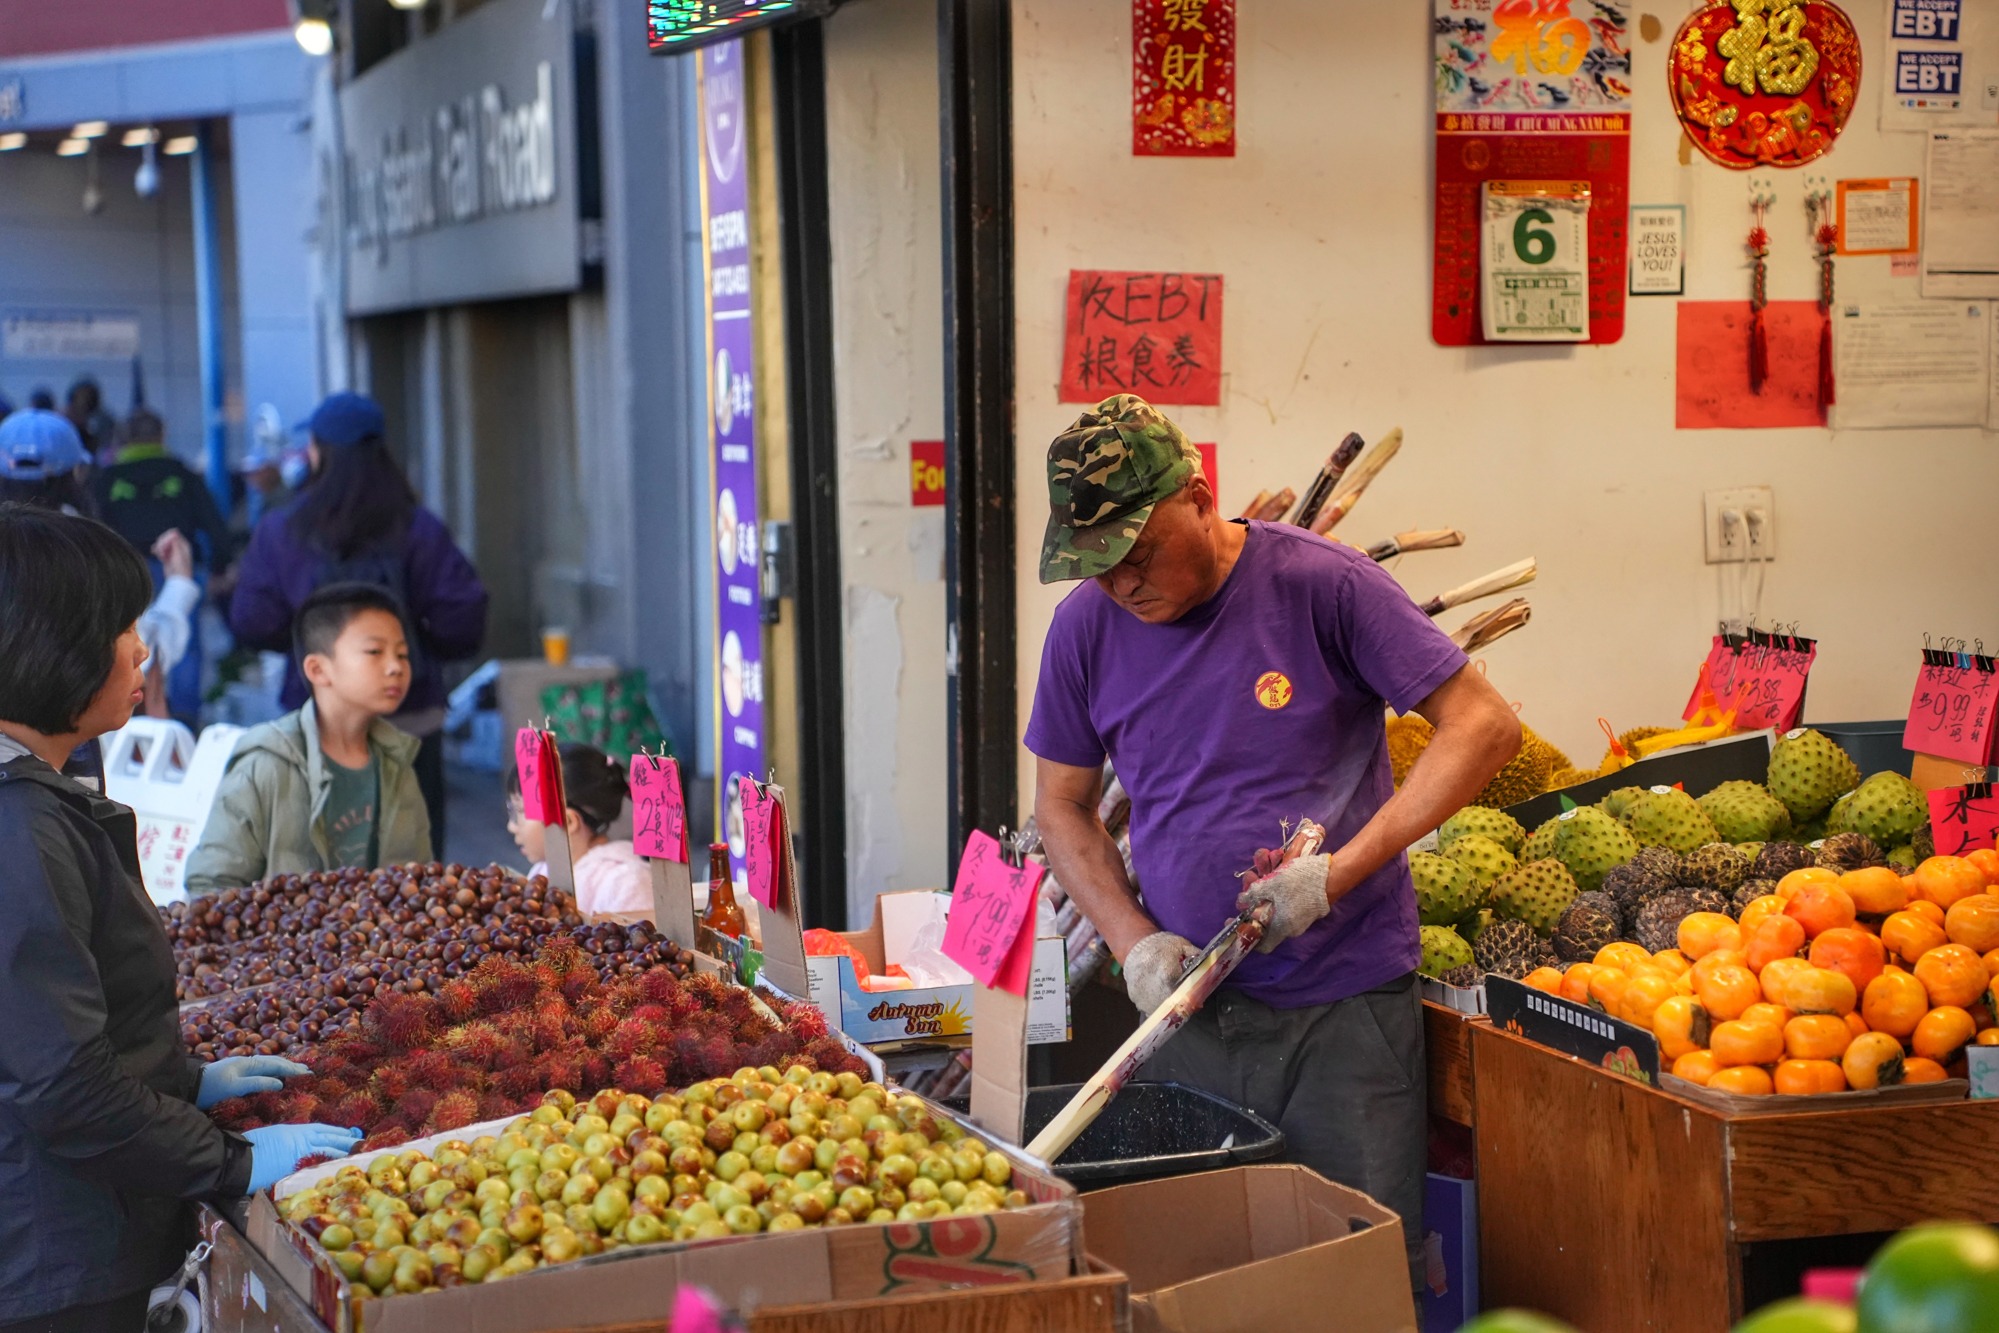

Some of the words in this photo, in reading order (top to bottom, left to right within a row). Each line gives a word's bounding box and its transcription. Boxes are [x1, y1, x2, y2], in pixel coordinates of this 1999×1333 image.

[1895, 9, 1958, 37] EBT
[1901, 54, 1918, 64] WE
[1919, 55, 1958, 65] ACCEPT
[1898, 65, 1960, 91] EBT
[1513, 208, 1557, 265] 6
[1637, 232, 1677, 245] JESUS
[1637, 246, 1677, 258] LOVES
[1642, 260, 1674, 272] YOU!
[868, 1001, 944, 1021] Autumn
[904, 1014, 943, 1035] Sun
